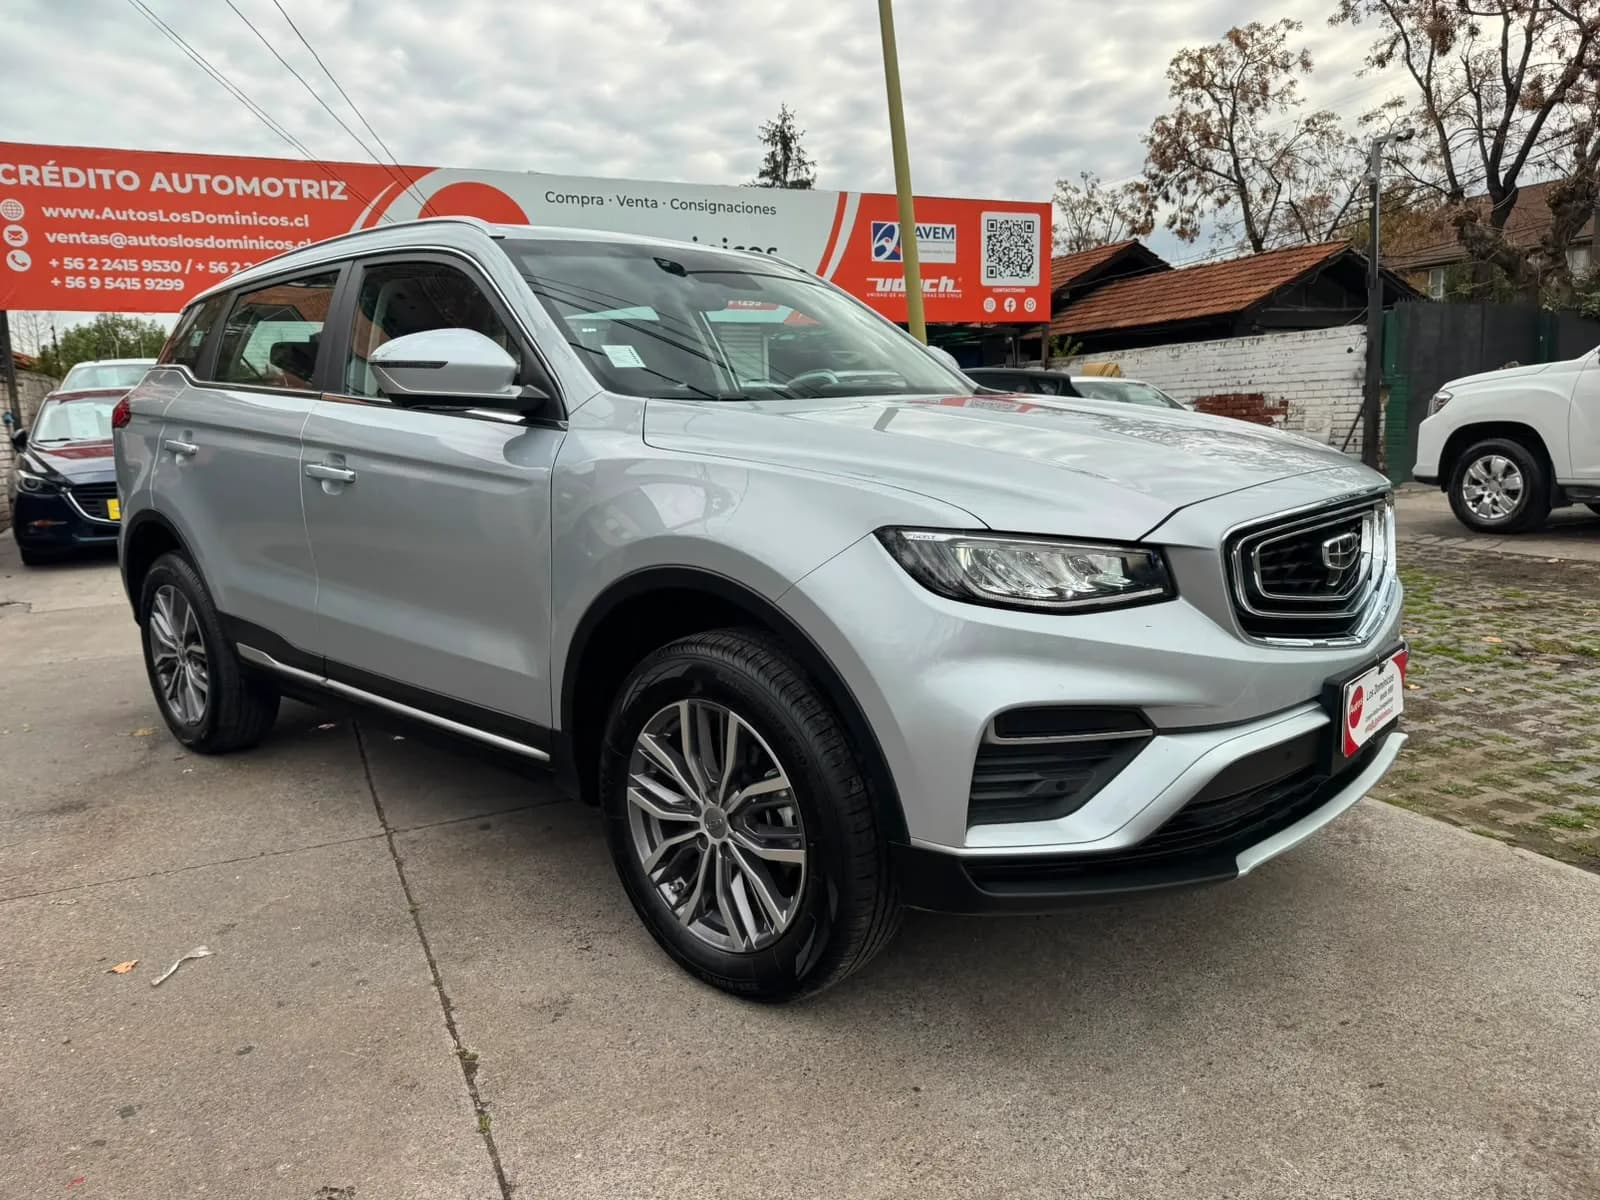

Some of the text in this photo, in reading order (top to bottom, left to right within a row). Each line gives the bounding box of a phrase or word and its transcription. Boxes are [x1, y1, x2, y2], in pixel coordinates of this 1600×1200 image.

[0, 160, 348, 201] CRÉDITO AUTOMOTRIZ
[545, 191, 777, 215] Compra Venta Consignaciones
[42, 206, 309, 227] www.AutosLosDominicos.cl
[914, 225, 955, 240] AVEM
[63, 257, 85, 270] 56
[88, 258, 99, 270] 2
[102, 258, 139, 271] 2415
[141, 260, 182, 273] 9530
[209, 261, 229, 274] 56
[65, 276, 86, 289] 56
[89, 277, 101, 289] 9
[104, 277, 141, 290] 5415
[144, 278, 185, 291] 9299
[866, 276, 962, 293] udch
